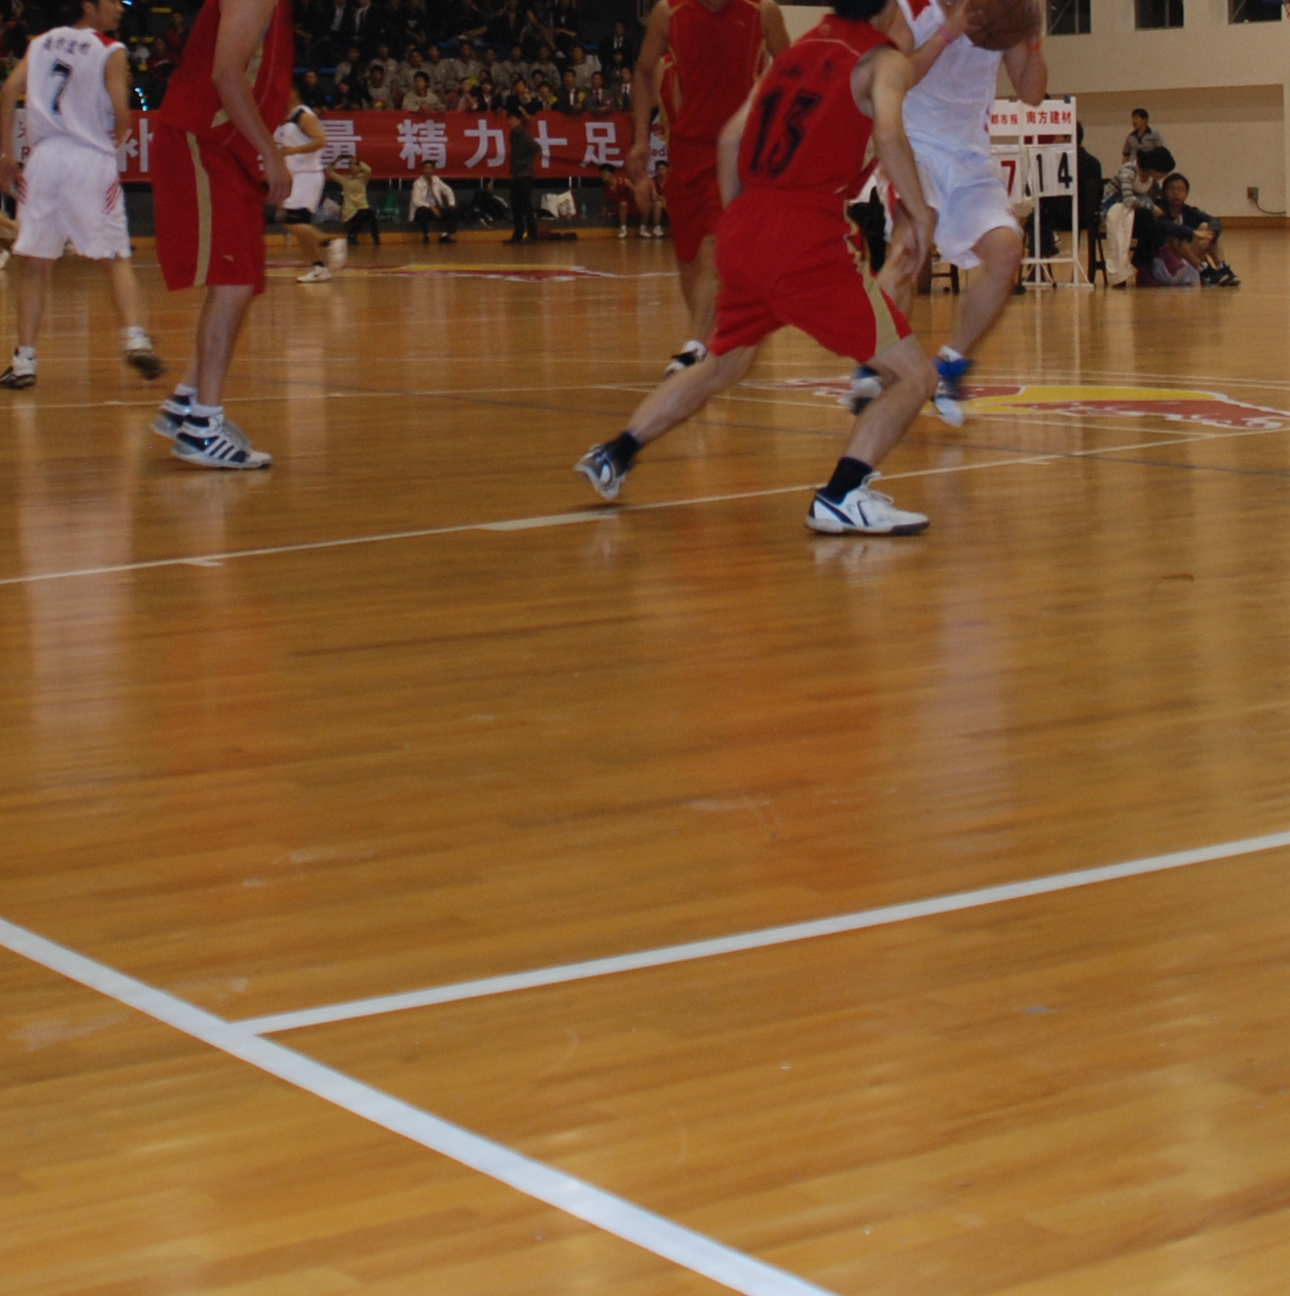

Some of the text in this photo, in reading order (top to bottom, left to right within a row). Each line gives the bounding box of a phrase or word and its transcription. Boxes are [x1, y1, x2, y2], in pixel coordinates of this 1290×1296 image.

[50, 58, 73, 115] 7
[397, 116, 625, 170] 精力十足
